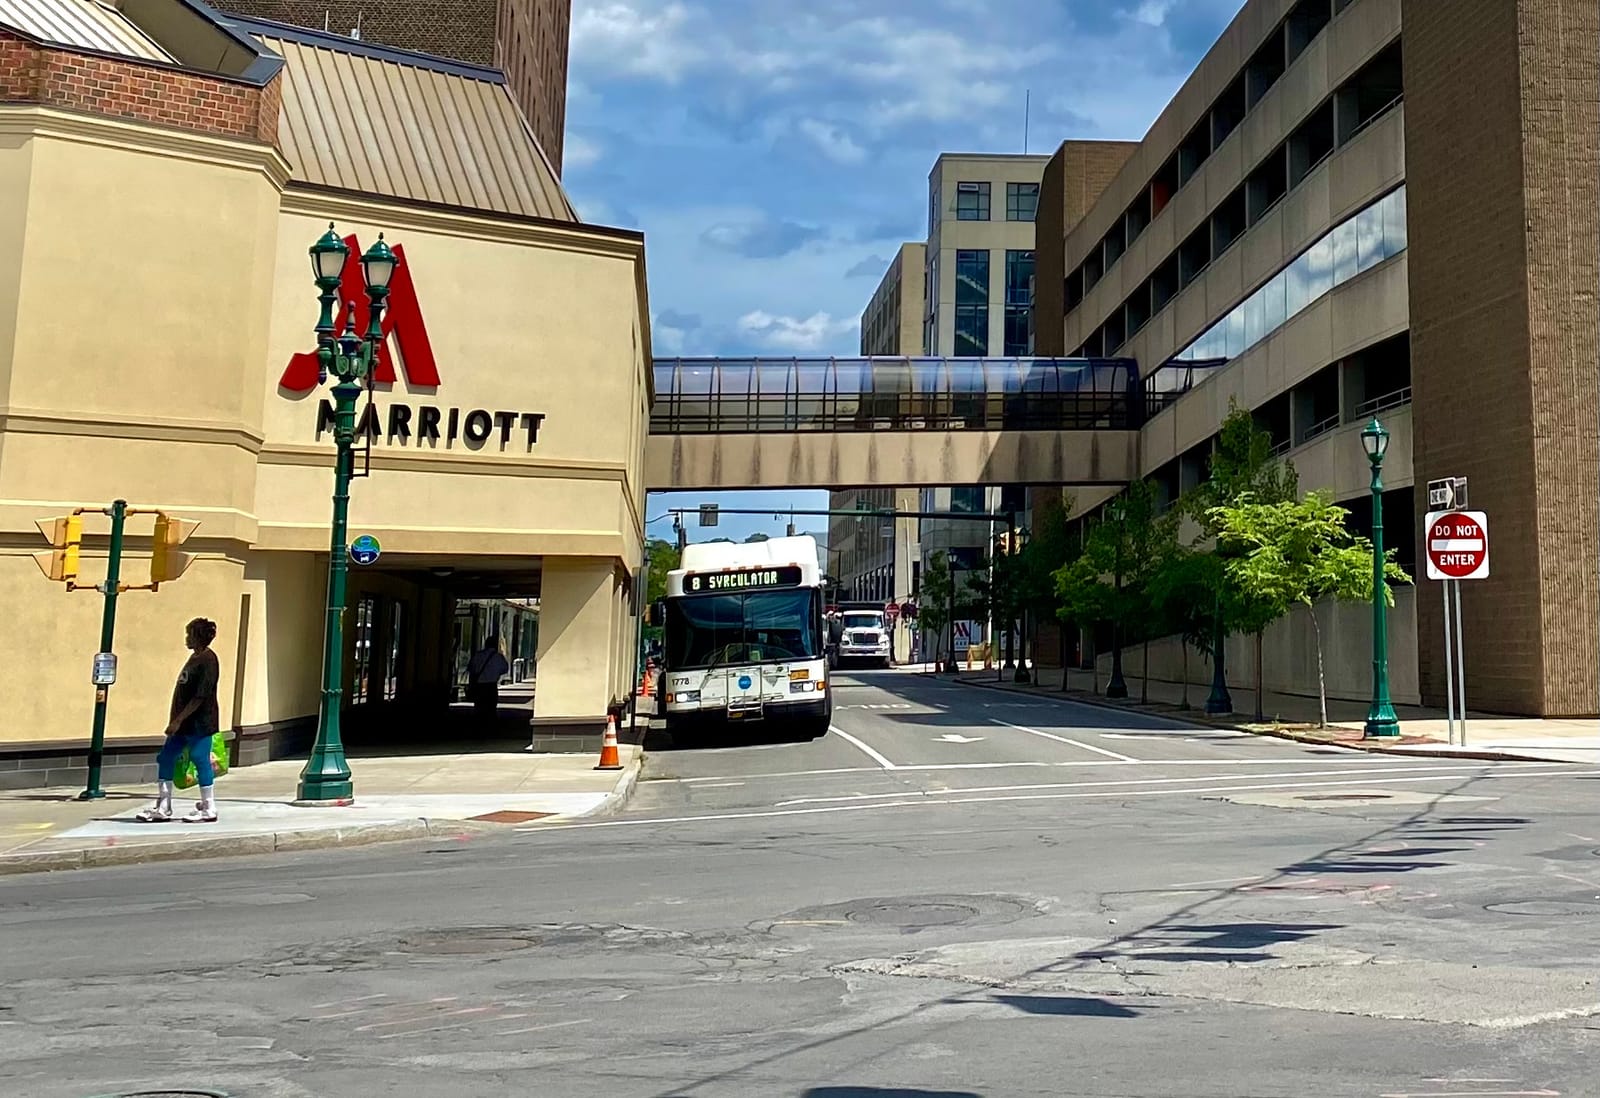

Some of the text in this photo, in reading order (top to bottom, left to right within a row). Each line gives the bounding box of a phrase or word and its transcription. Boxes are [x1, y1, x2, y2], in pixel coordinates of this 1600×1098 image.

[316, 399, 546, 446] MARRIOTT
[1435, 525, 1478, 536] DO NOT
[1440, 554, 1475, 566] ENTER
[692, 571, 777, 590] 8 SYRCULATOR
[671, 677, 690, 686] 1778
